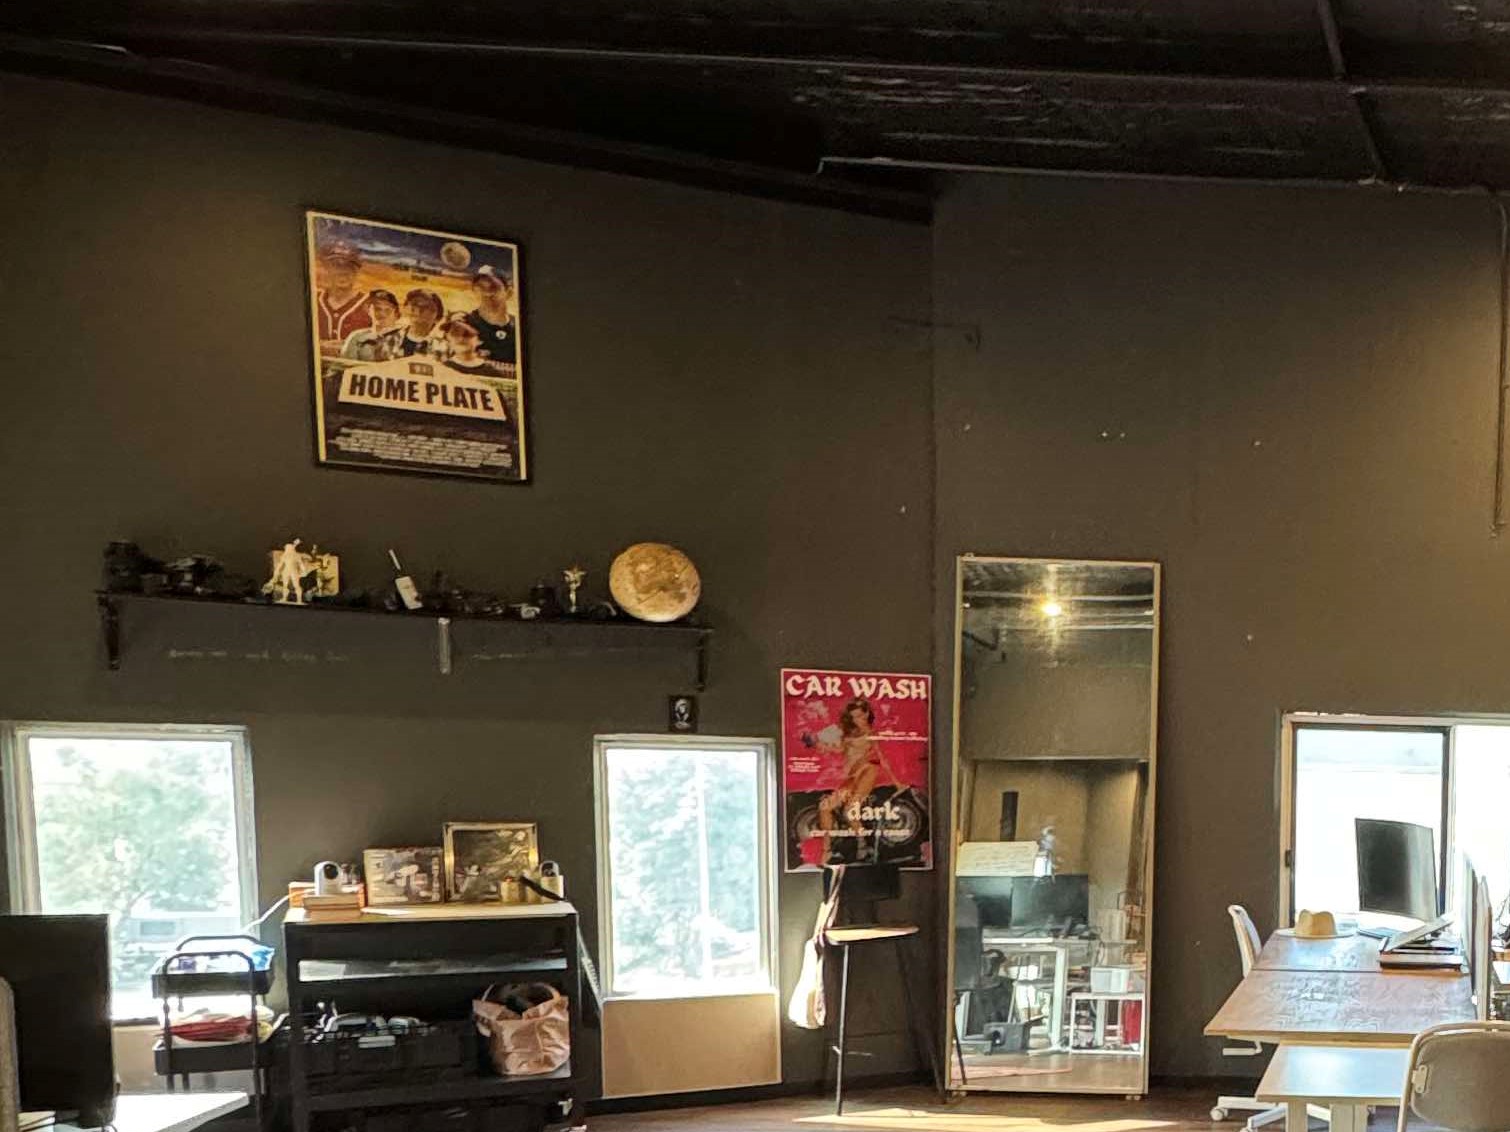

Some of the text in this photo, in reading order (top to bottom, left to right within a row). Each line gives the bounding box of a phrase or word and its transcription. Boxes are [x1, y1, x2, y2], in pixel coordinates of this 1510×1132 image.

[349, 374, 495, 411] HOME PLATE
[786, 675, 927, 700] CAR WASH
[847, 801, 900, 821] dark
